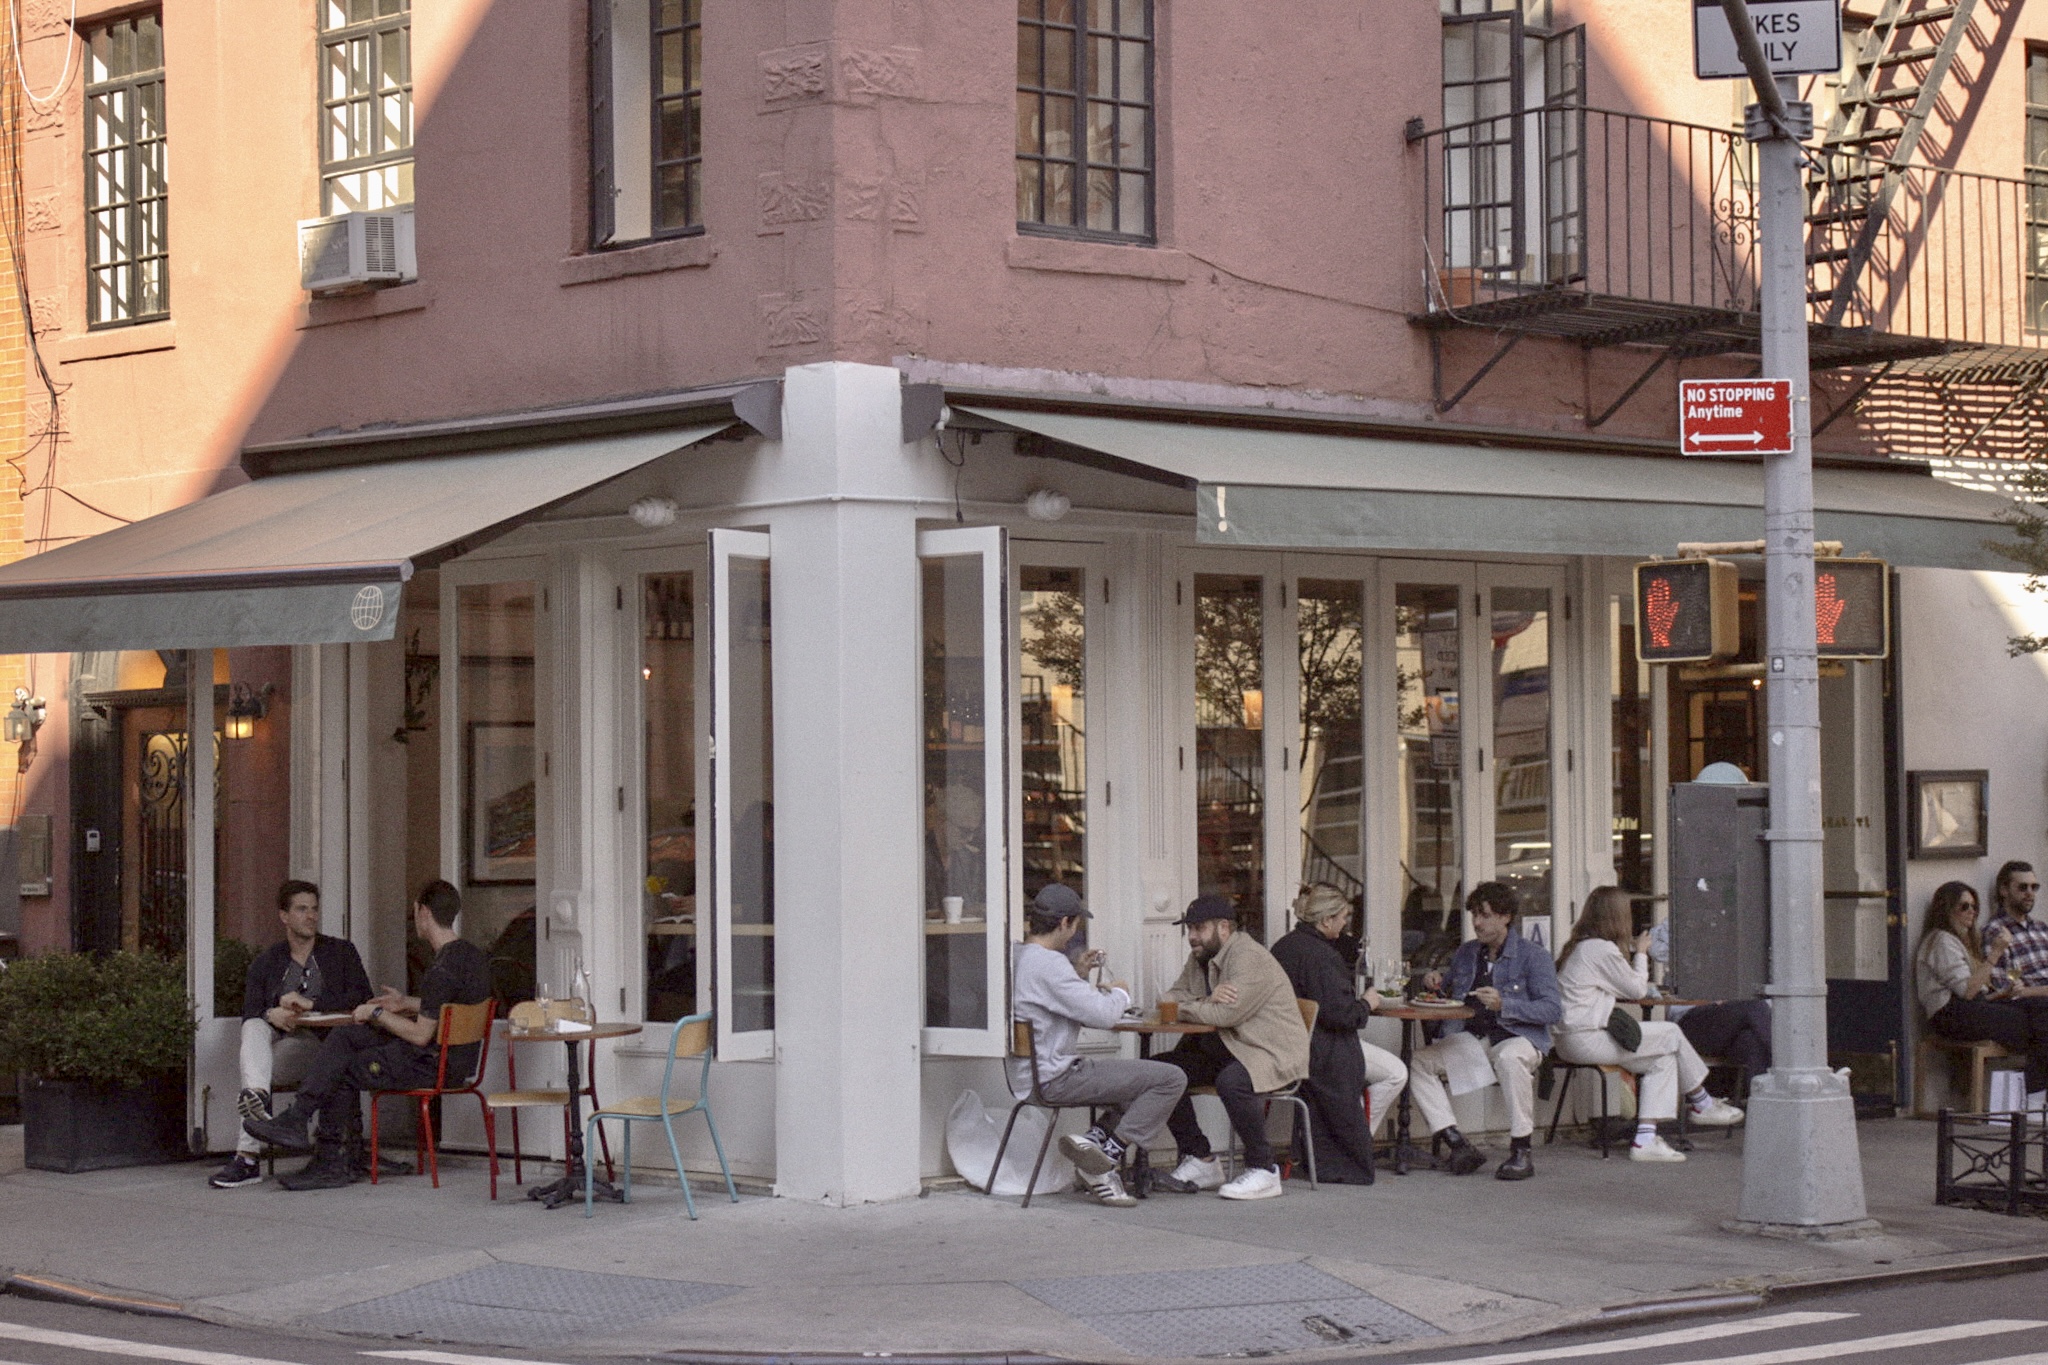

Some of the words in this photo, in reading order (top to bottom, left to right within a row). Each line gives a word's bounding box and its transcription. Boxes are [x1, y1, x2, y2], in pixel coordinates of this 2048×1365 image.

[1750, 13, 1800, 34] KES
[1737, 41, 1798, 62] LY
[1687, 388, 1706, 403] NO
[1709, 387, 1775, 402] STOPPING
[1688, 405, 1743, 421] Anytime
[1531, 923, 1544, 947] A
